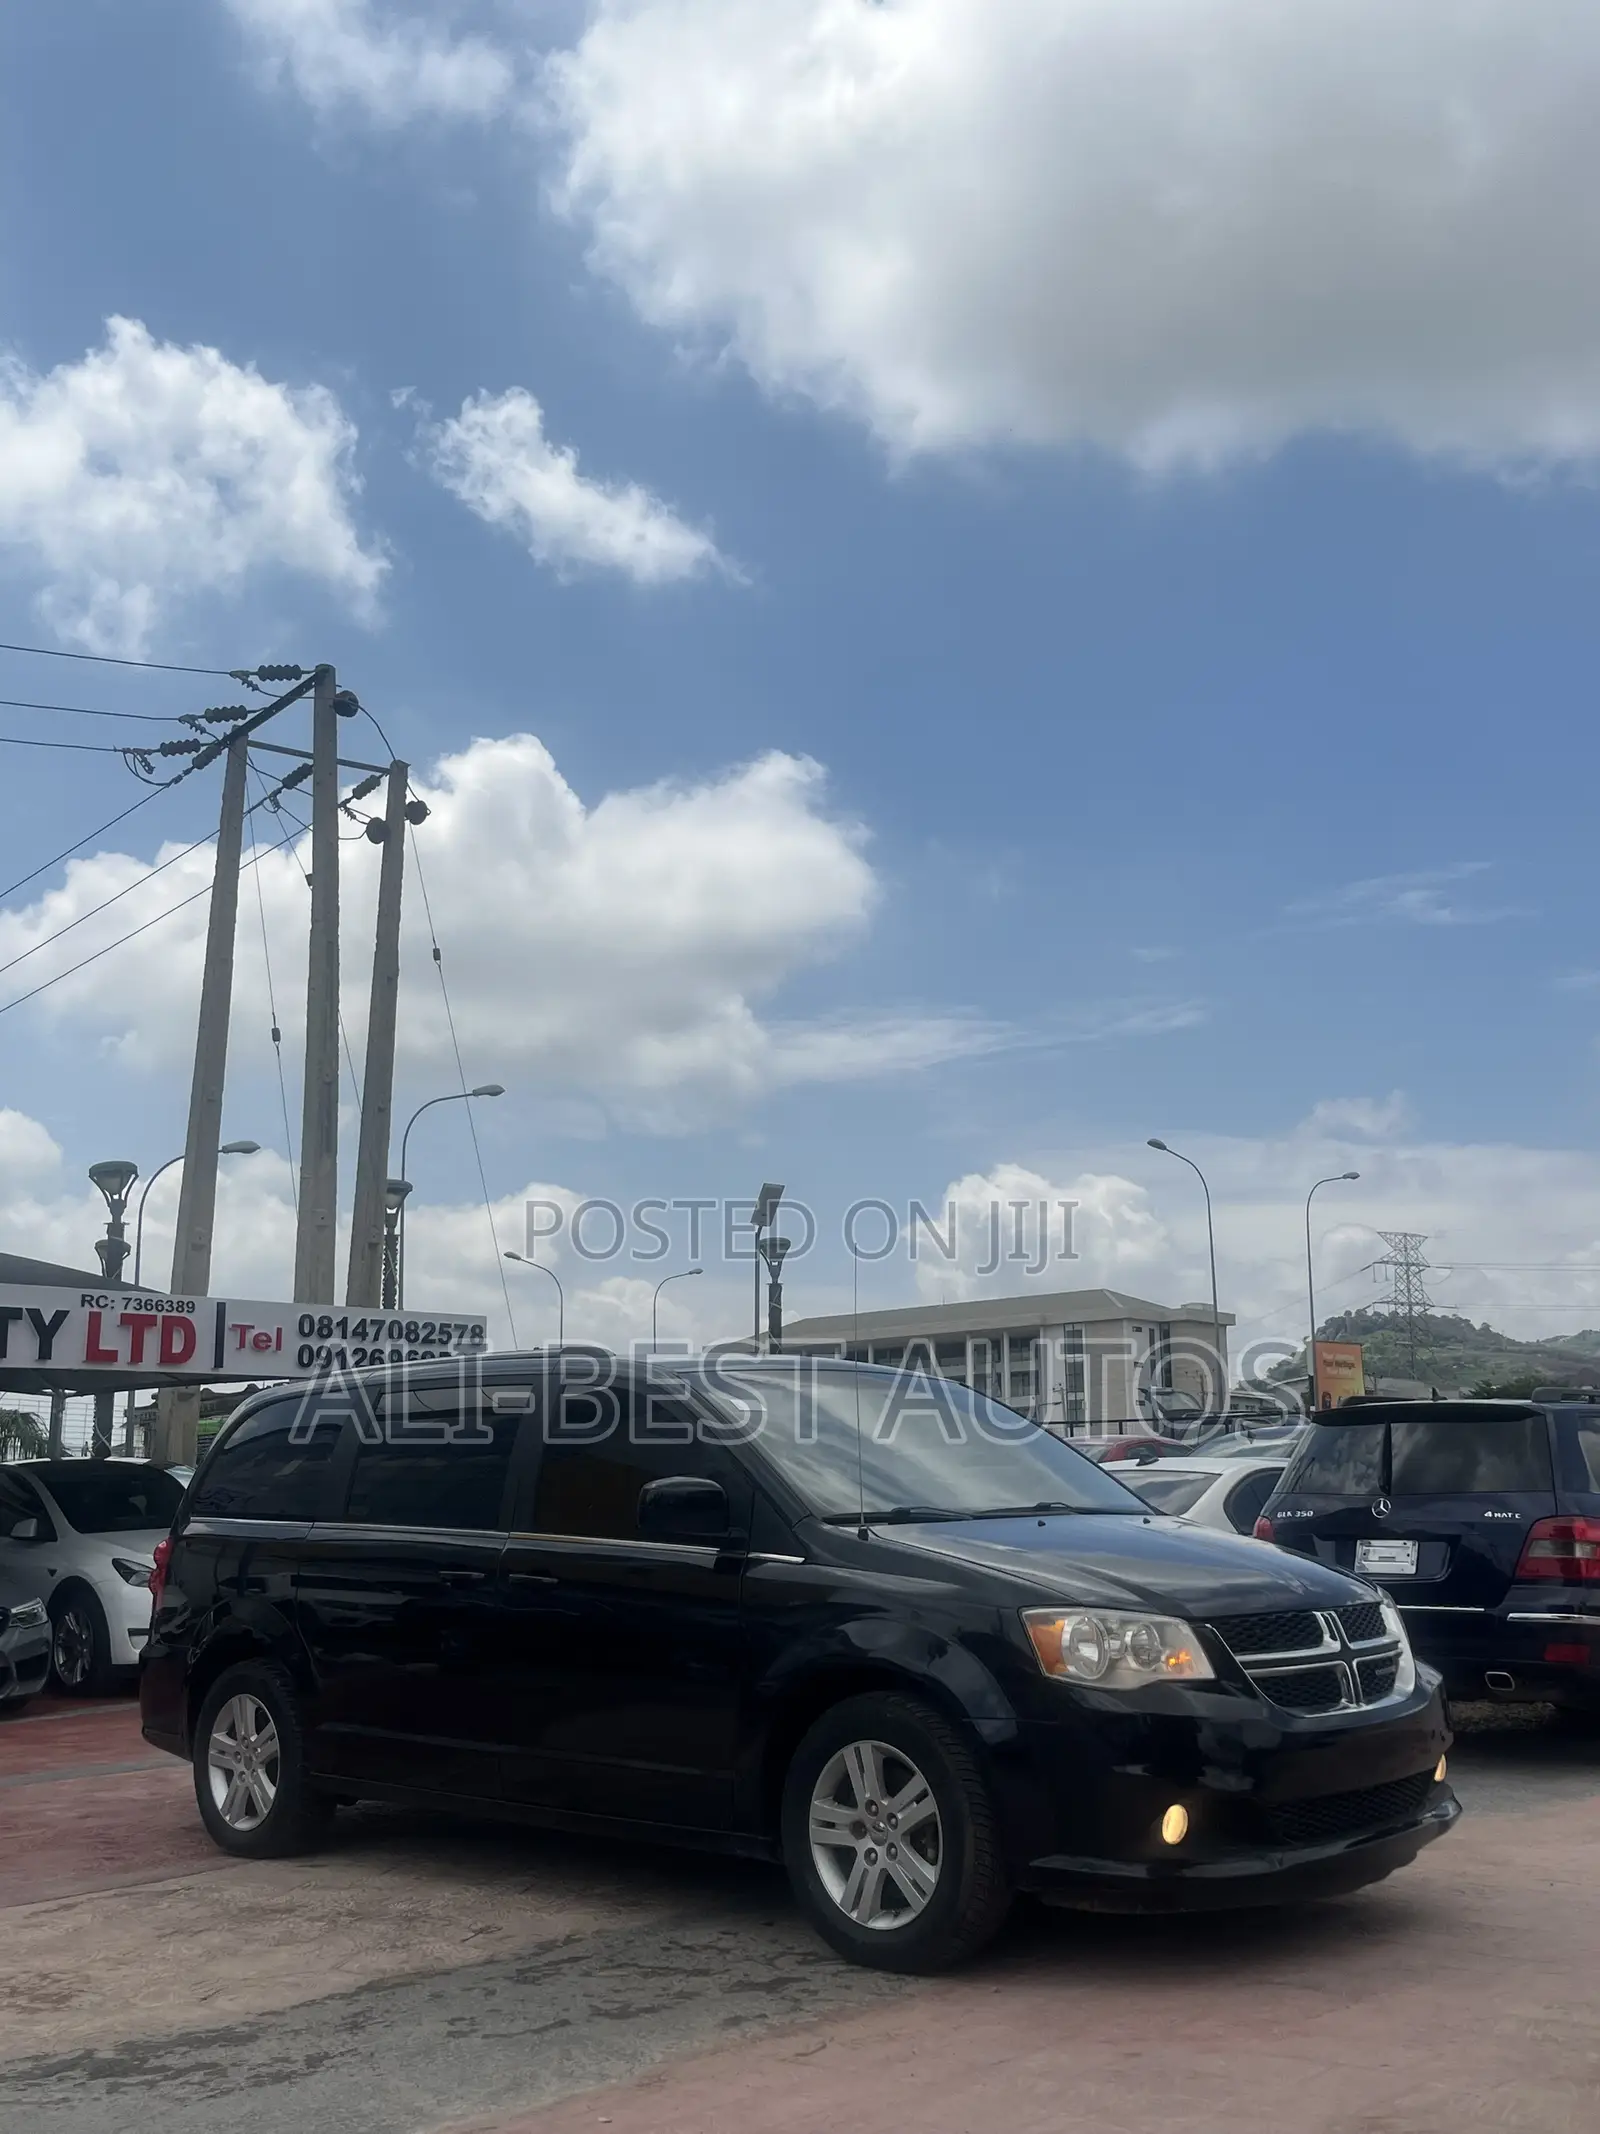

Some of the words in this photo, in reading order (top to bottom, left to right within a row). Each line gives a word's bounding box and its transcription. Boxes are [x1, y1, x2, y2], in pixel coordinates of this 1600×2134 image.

[80, 1294, 116, 1311] RC:
[121, 1296, 196, 1314] 7366389
[84, 1311, 197, 1365] LTD
[229, 1323, 283, 1352] Tel
[298, 1313, 485, 1346] 08147082578
[1294, 1510, 1314, 1518] 350
